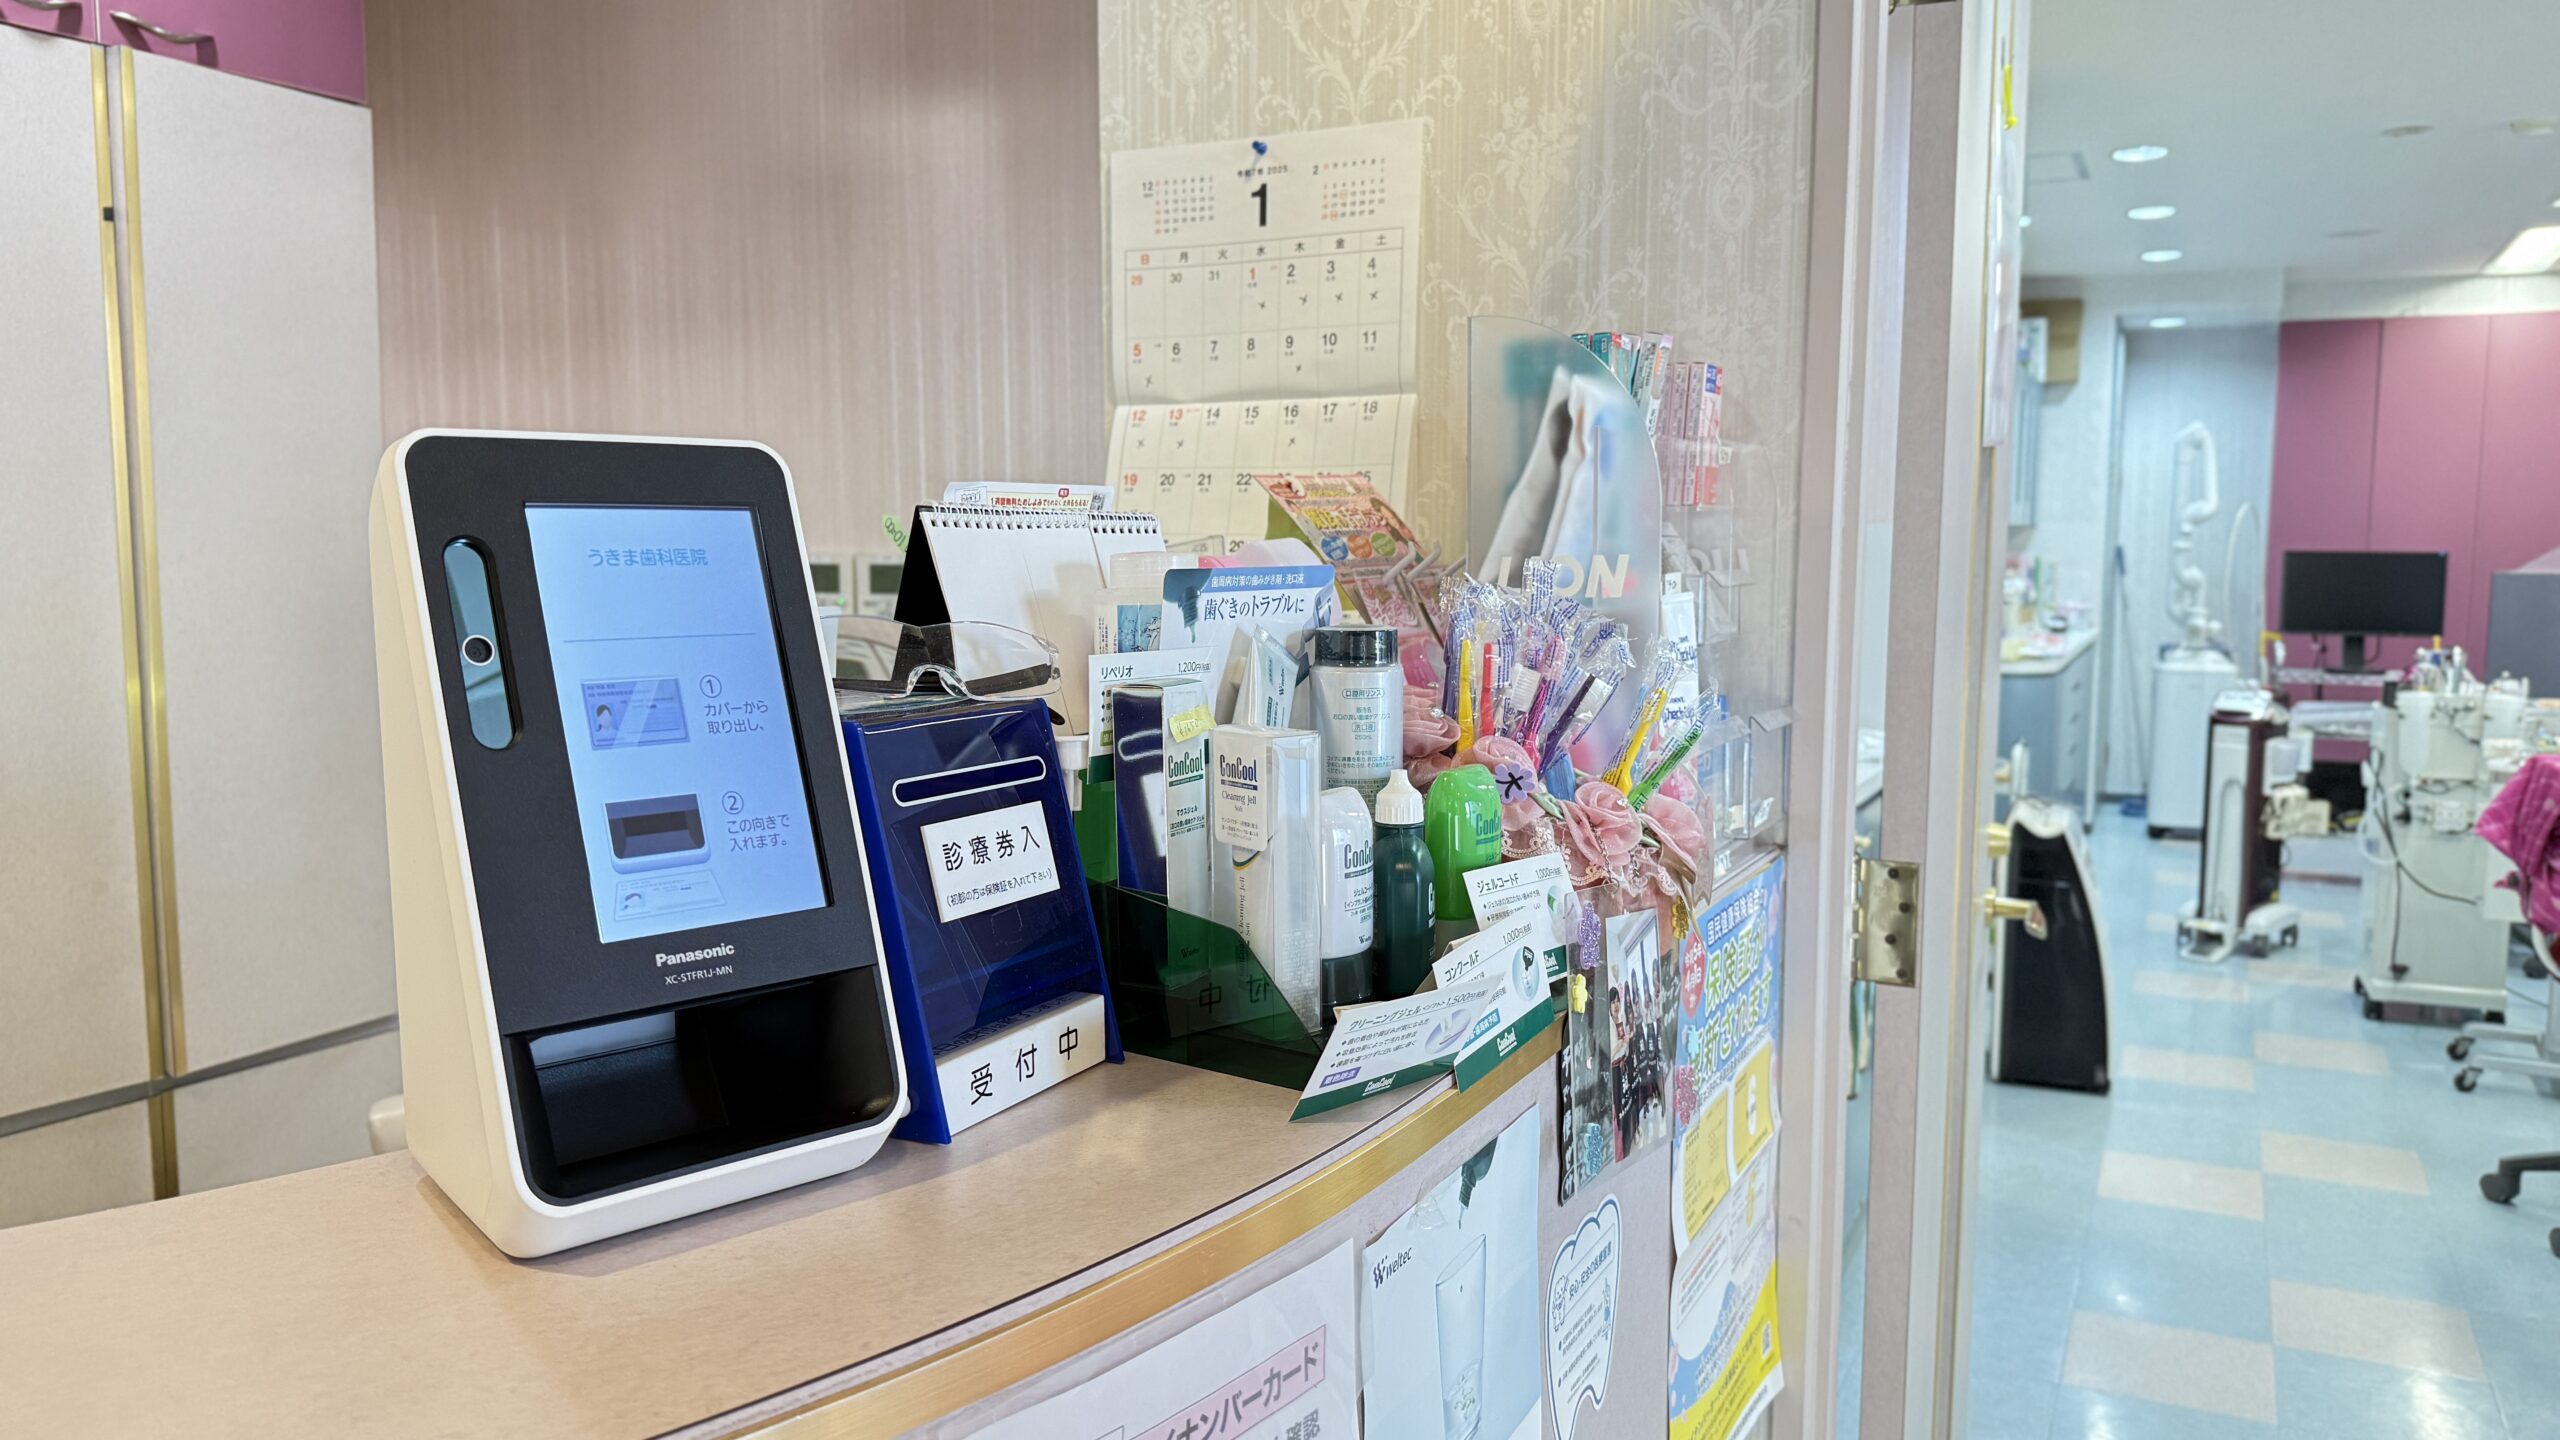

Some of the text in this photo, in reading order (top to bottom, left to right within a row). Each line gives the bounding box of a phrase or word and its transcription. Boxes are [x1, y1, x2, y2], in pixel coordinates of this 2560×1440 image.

[1312, 165, 1319, 175] 2
[1251, 183, 1267, 227] 1
[1141, 235, 1387, 265] 日 月 火 水 木 金 土
[1131, 258, 1376, 285] 29 30 31 1 2 3 4
[1133, 331, 1377, 357] 5 6 7 8 9 10 11
[1131, 402, 1378, 422] 12 13 14 15 16 17 18
[1123, 474, 1137, 486] 19
[1160, 474, 1175, 486] 20
[1198, 474, 1212, 486] 21
[1236, 474, 1252, 486] 22
[587, 547, 708, 568] うきま歯科医院
[1498, 554, 1630, 599] LON
[1204, 594, 1304, 620] 歯ぐきのトラブルに
[1101, 665, 1133, 679] リペリオ
[704, 700, 768, 717] カバーから
[707, 718, 765, 735] 取り出し、
[1168, 748, 1203, 778] ConCool
[1220, 754, 1258, 782] ConCool
[1222, 790, 1257, 805] Cleaning Jell
[727, 814, 790, 834] この向きで
[730, 833, 788, 852] 入れます。
[942, 825, 1040, 872] 診療券入
[947, 868, 1052, 907] (初診の方は保険証を入れて下さい)
[1477, 873, 1519, 893] ジェルコートF
[655, 943, 735, 967] Panasonic
[1445, 950, 1480, 982] コンクールF
[1705, 915, 1767, 1017] 保険証が
[665, 965, 733, 985] XC-STFR1J-MN
[1349, 1006, 1422, 1031] クリーニングジェル
[1497, 1026, 1517, 1051] ConCool
[970, 1026, 1078, 1106] 受付中
[1364, 1073, 1397, 1092] ConCool
